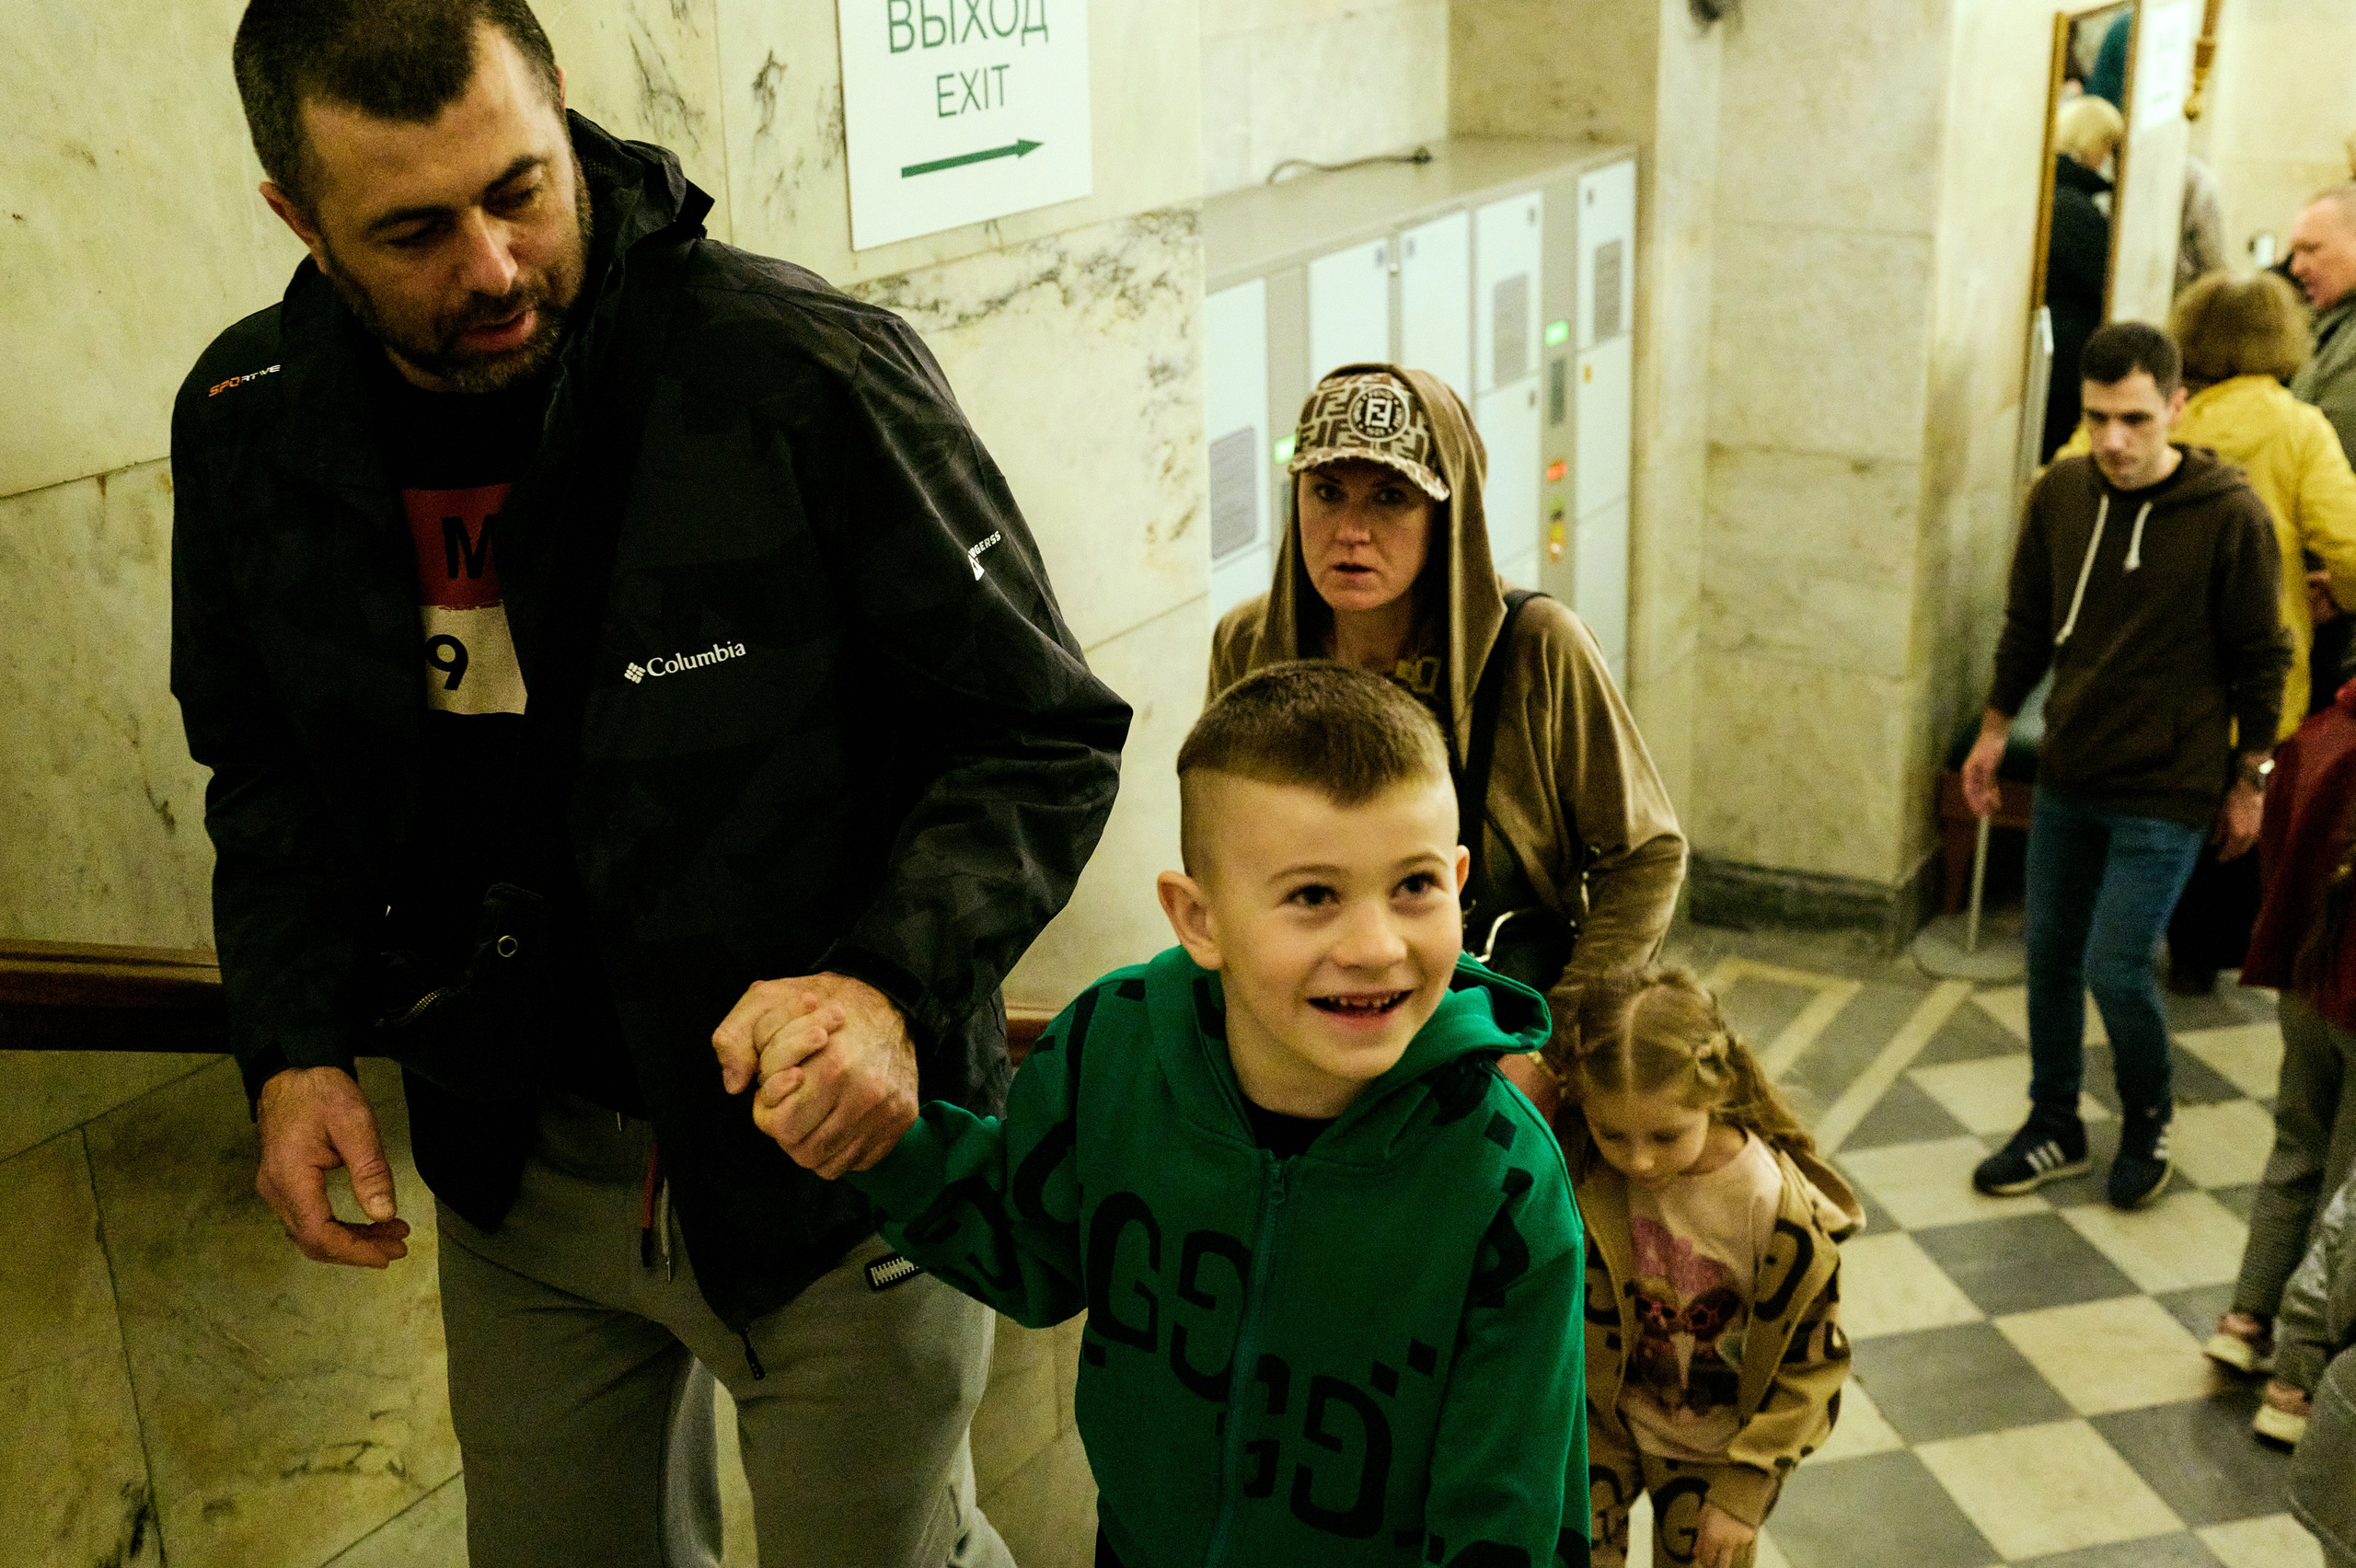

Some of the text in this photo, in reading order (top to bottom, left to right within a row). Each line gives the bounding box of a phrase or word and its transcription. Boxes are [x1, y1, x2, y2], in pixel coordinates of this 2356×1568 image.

[887, 0, 1048, 53] ВЫХОД
[936, 63, 1011, 118] EXIT
[441, 514, 498, 580] M
[425, 633, 469, 691] 9
[646, 640, 746, 677] Columbia
